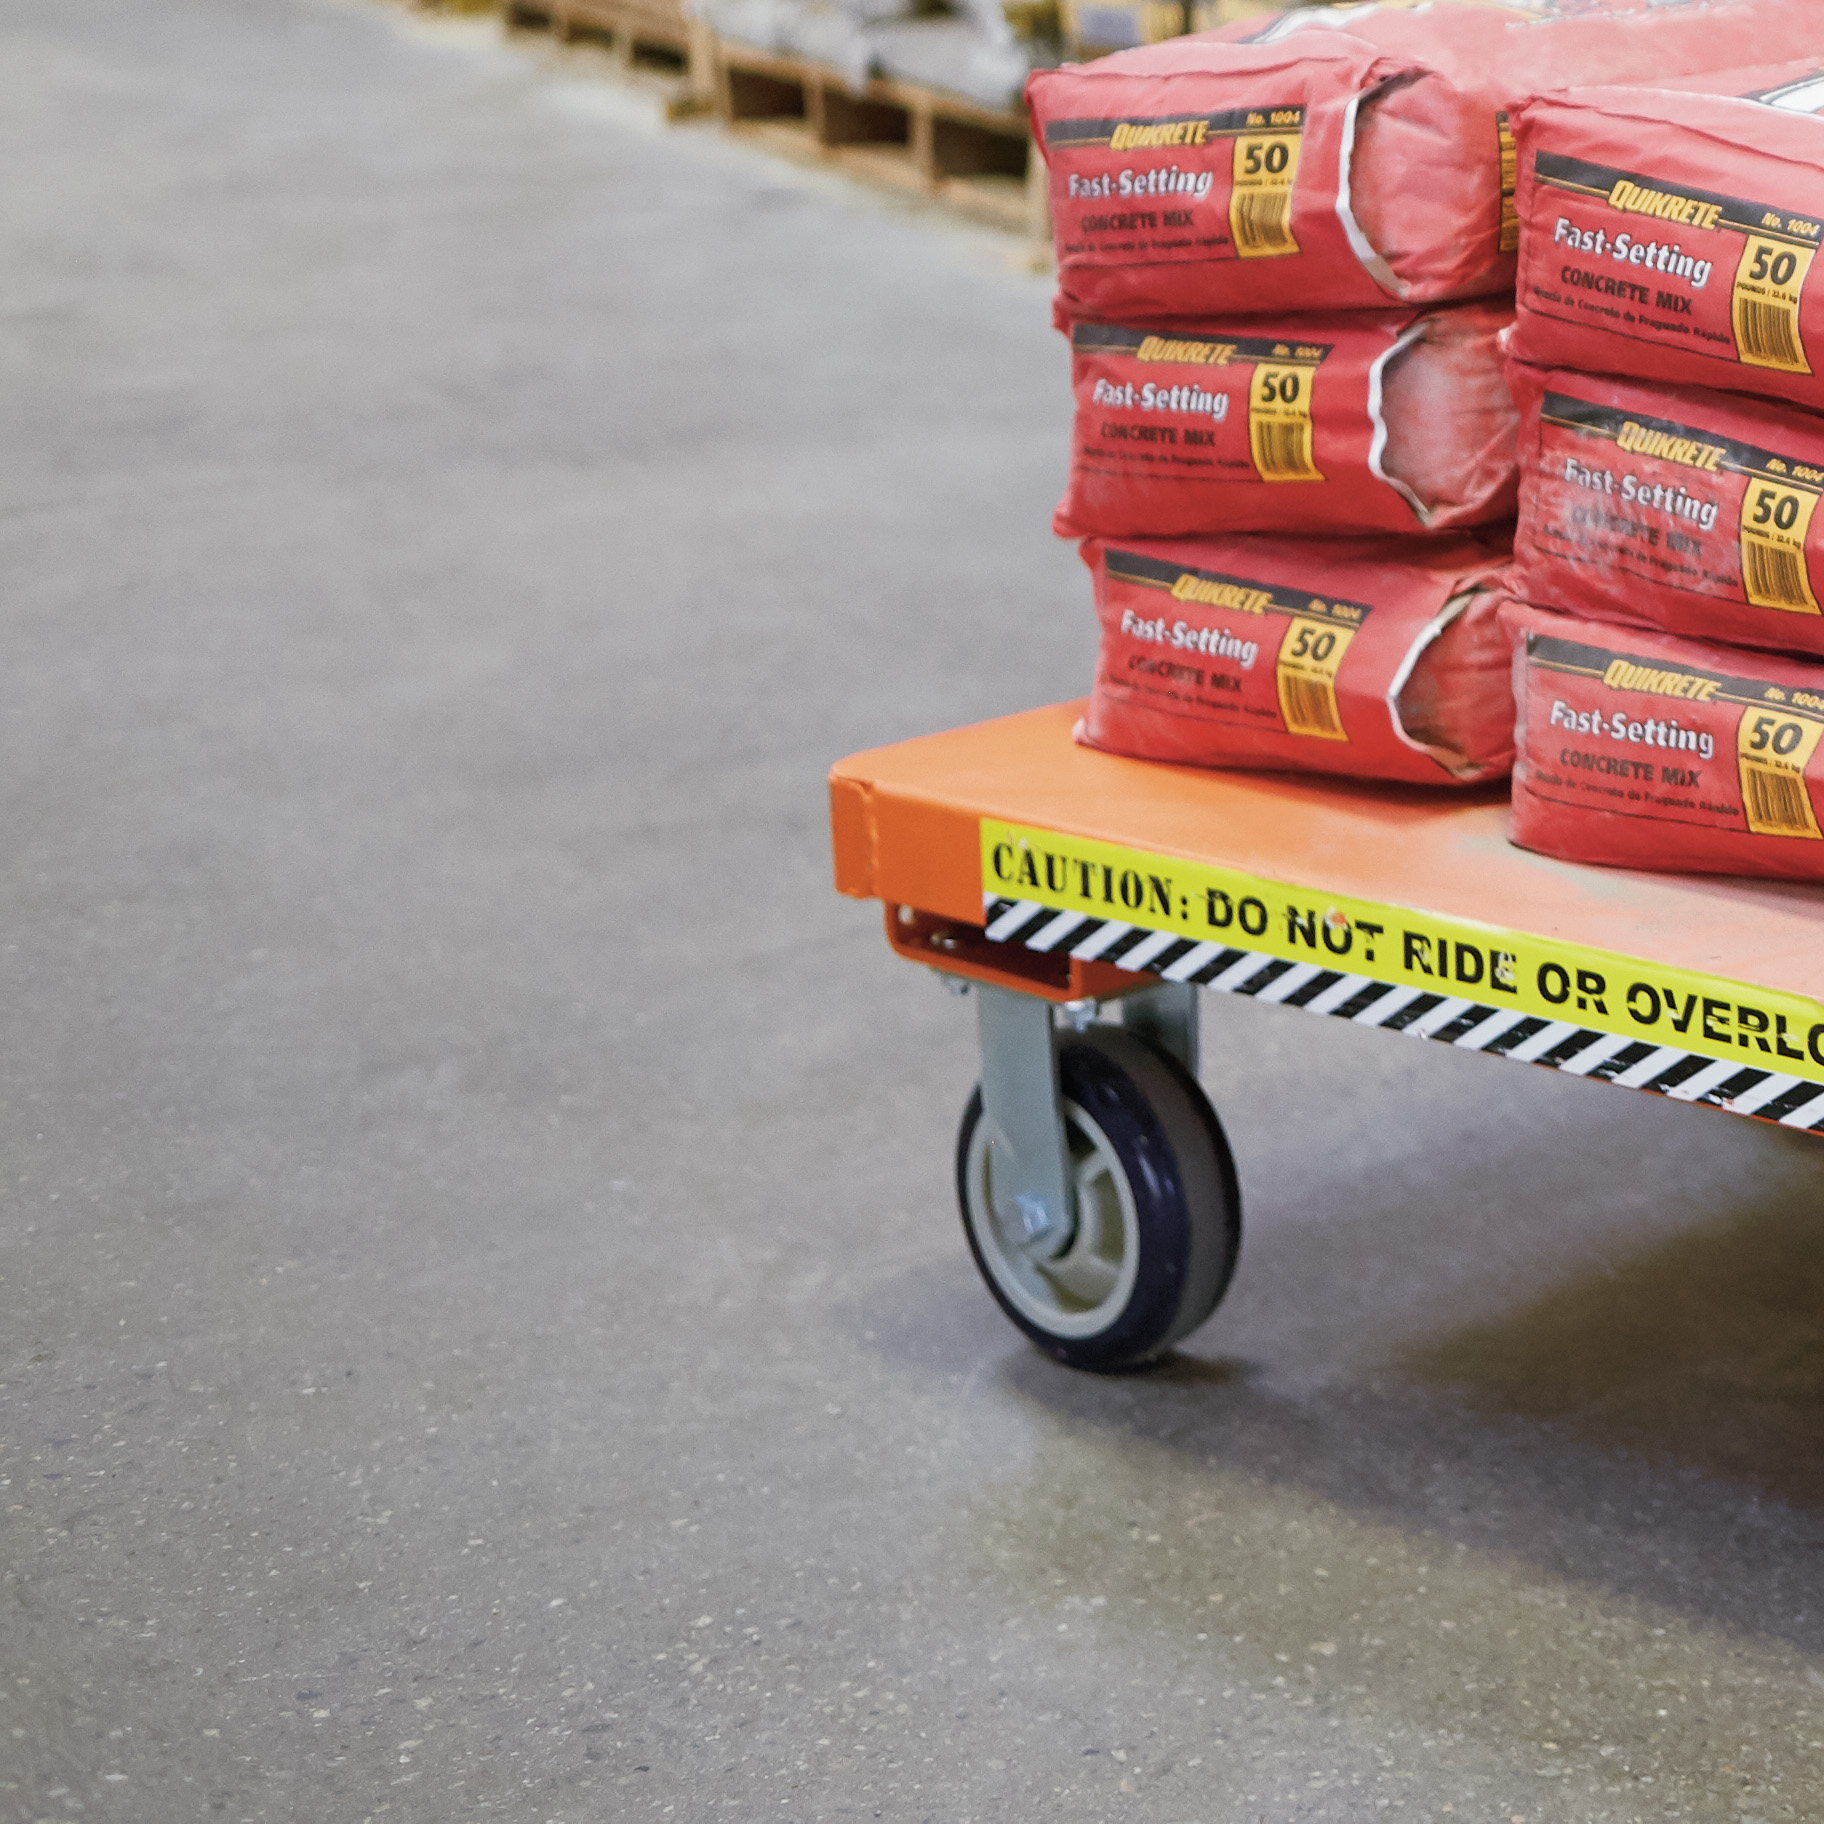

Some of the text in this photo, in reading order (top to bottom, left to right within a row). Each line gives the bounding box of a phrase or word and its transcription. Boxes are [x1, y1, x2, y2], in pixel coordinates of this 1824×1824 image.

[1109, 120, 1209, 152] QUIKRETE
[1245, 142, 1289, 175] 50
[1068, 165, 1214, 199] Fast-Setting
[1608, 180, 1723, 230] QUIKRETE
[1554, 218, 1713, 289] Fast-Setting
[1751, 246, 1797, 286] 50
[1137, 336, 1238, 366] QUIKRETE
[1093, 378, 1229, 420] Fast-Setting
[1261, 372, 1299, 404] 50
[1617, 421, 1727, 472] QUIKRETE
[1564, 457, 1719, 531] Fast-Setting
[1752, 489, 1800, 530] 50
[1171, 574, 1274, 616] QUIKRETE
[1120, 610, 1259, 669] Fast-Setting
[1291, 627, 1336, 660] 50
[1603, 659, 1722, 703] QUIKRETE
[1549, 701, 1714, 760] Fast-Setting
[1751, 717, 1803, 755] 50
[993, 842, 1189, 922] CAUTION:
[1206, 888, 1269, 937] DO
[1287, 906, 1384, 963] NOT
[1403, 930, 1518, 996] RIDE
[1537, 961, 1609, 1017] OR
